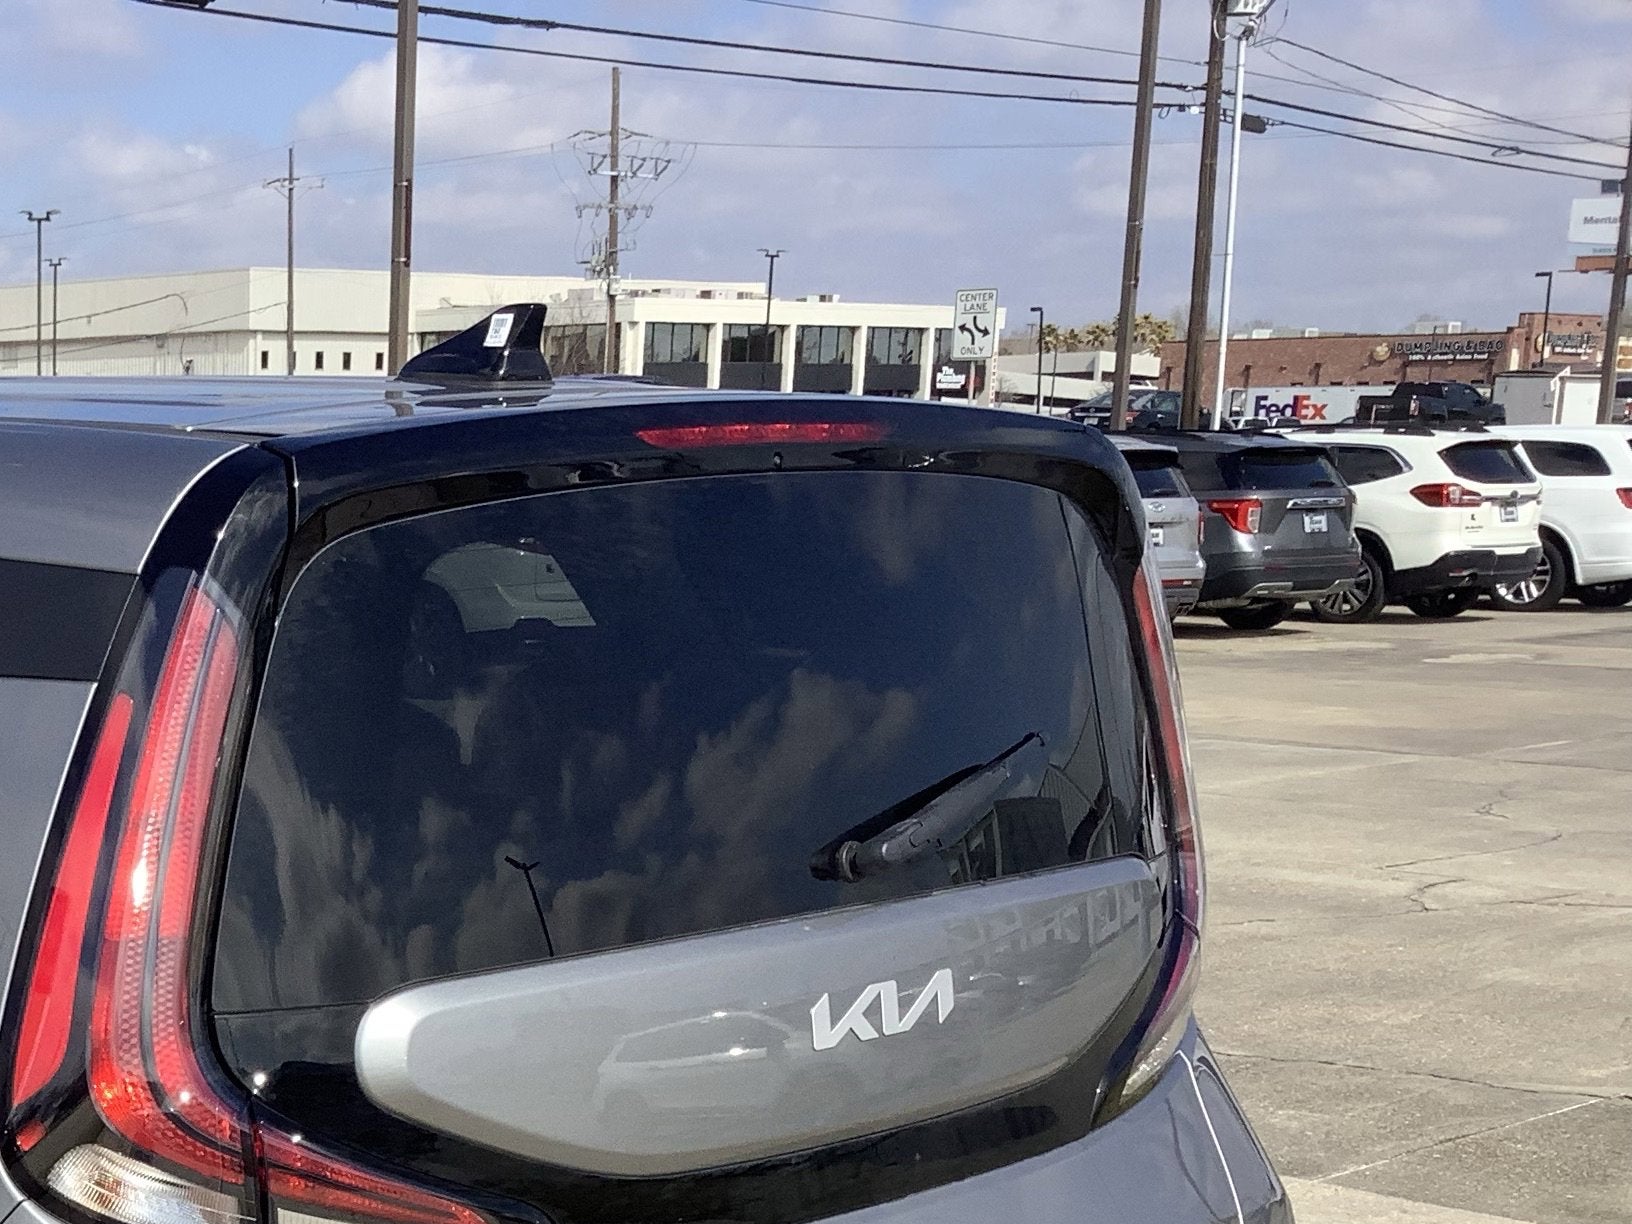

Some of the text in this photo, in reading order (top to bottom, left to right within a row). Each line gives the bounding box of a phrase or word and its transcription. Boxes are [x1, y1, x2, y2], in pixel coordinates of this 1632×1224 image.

[959, 292, 994, 302] CENTER
[963, 303, 988, 312] LANE
[960, 346, 985, 355] ONLY
[1254, 394, 1328, 421] FedEx
[810, 968, 955, 1051] KIA
